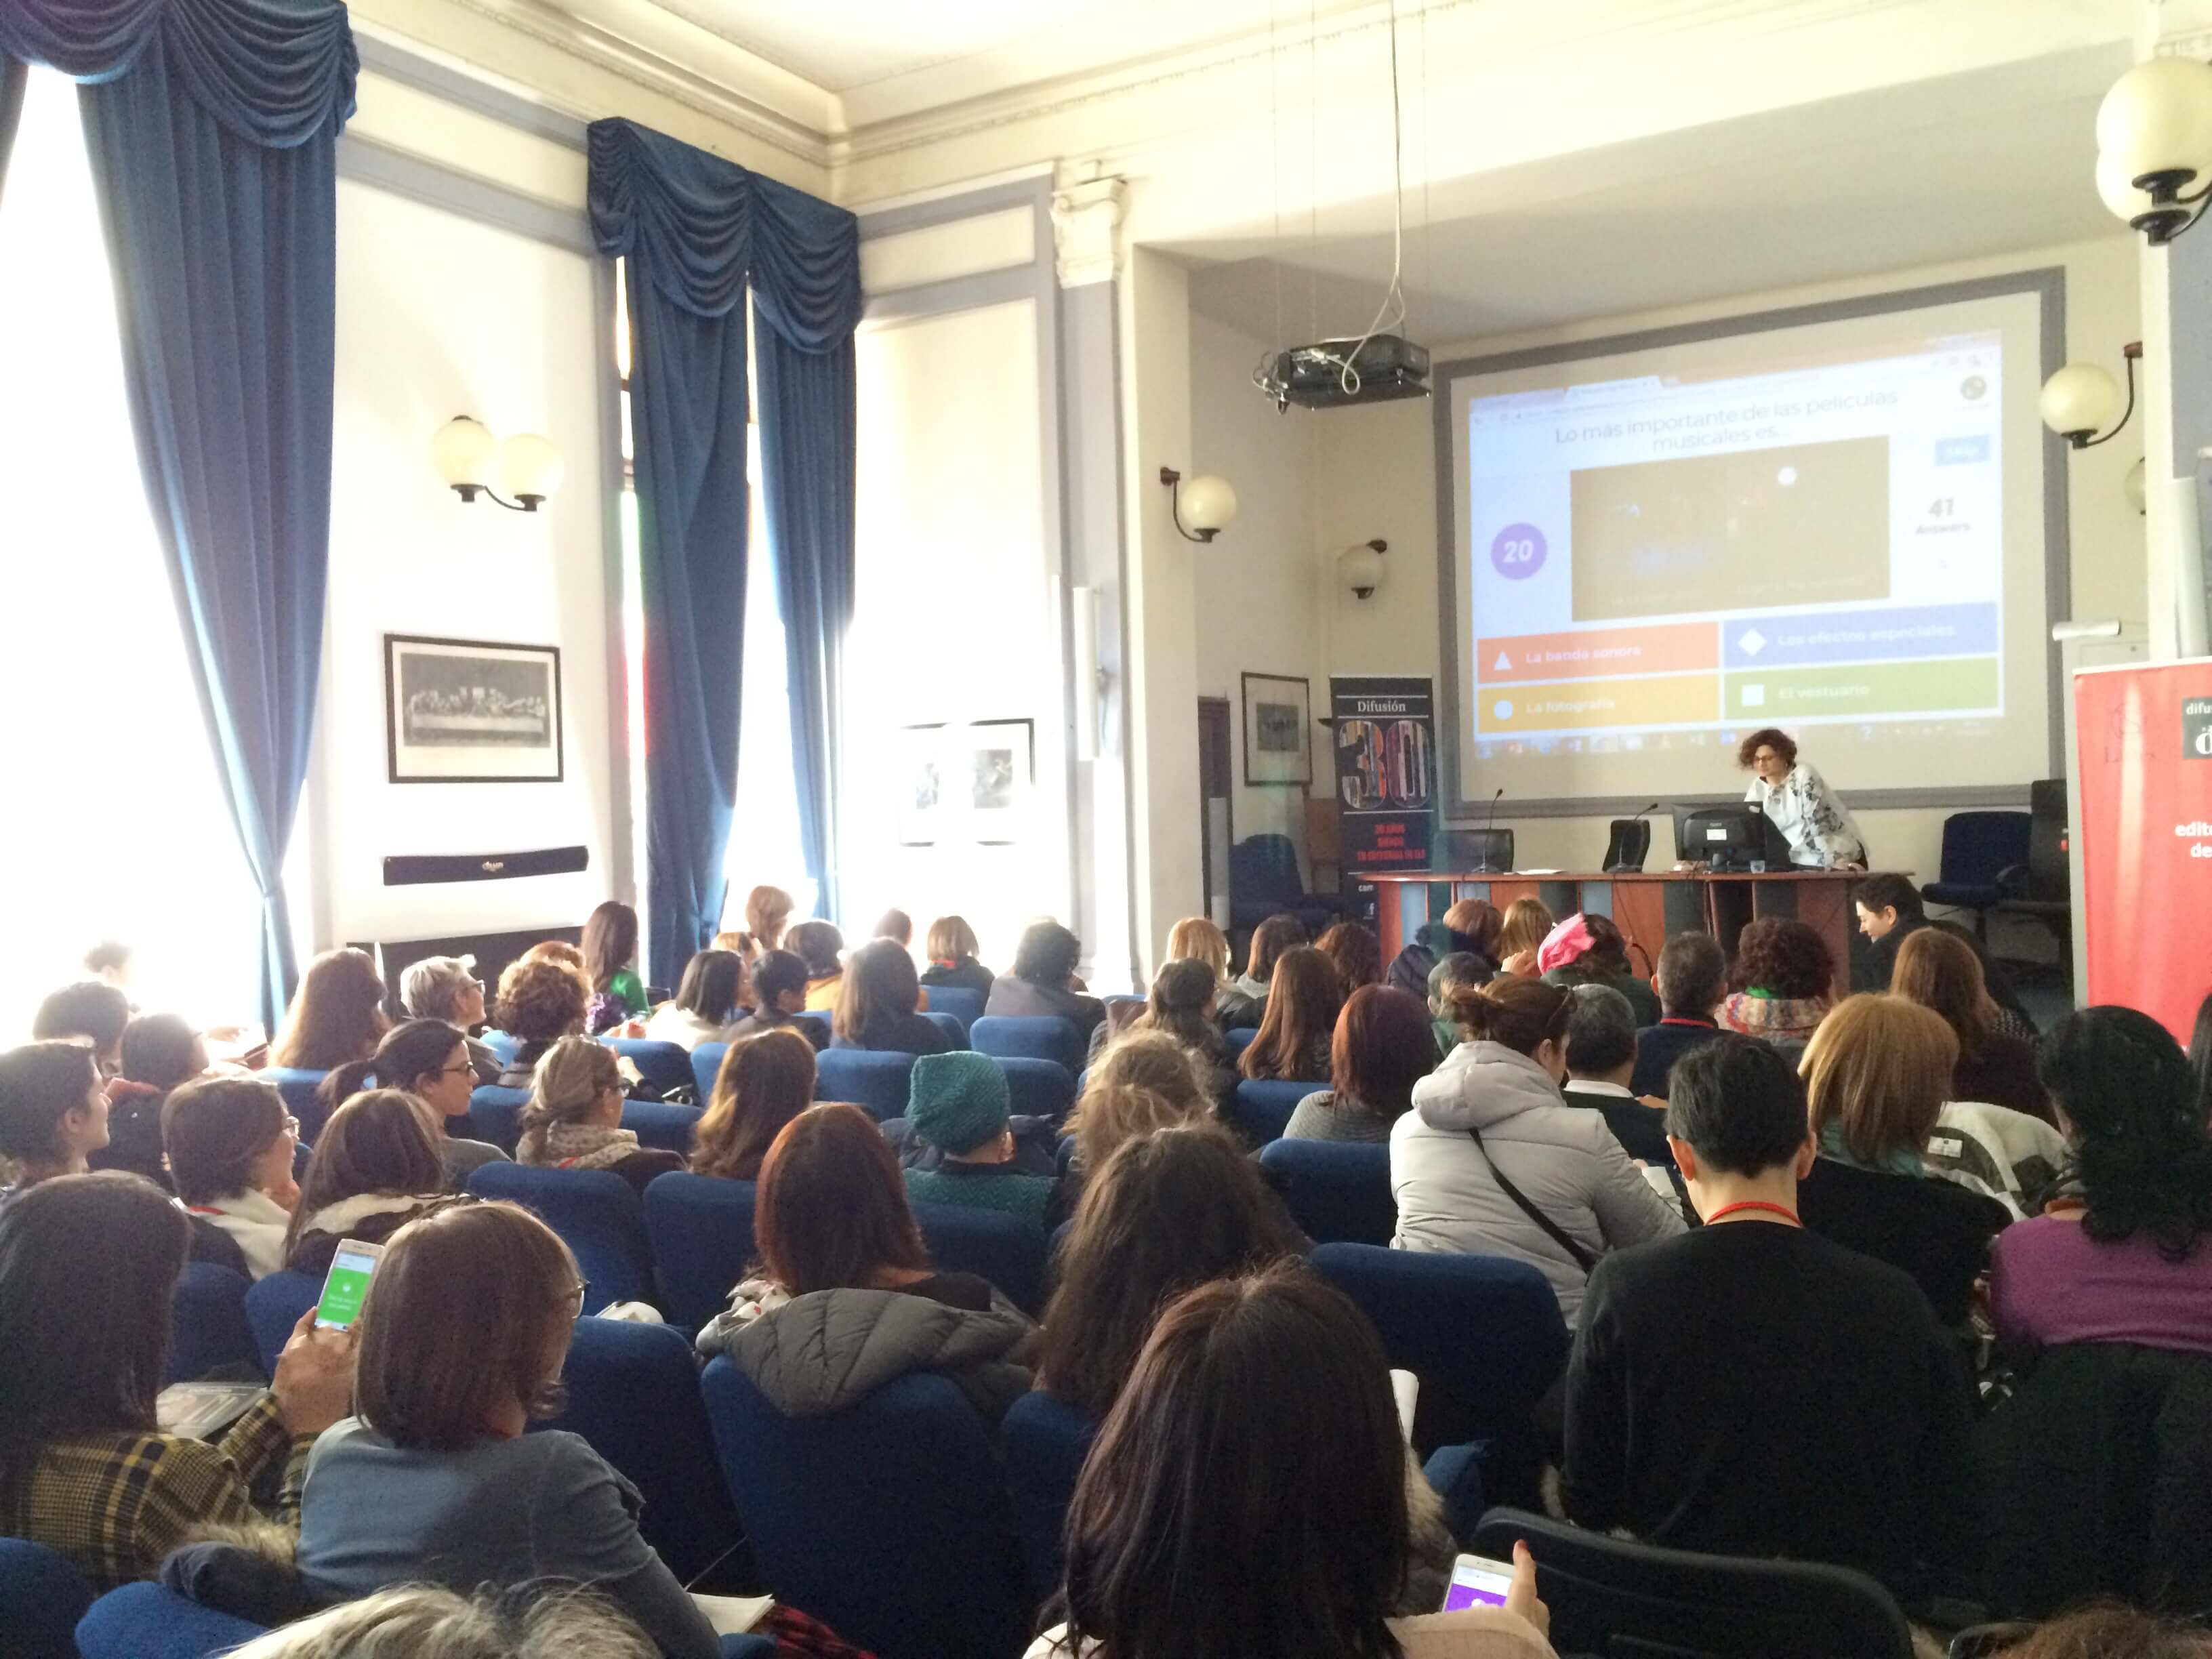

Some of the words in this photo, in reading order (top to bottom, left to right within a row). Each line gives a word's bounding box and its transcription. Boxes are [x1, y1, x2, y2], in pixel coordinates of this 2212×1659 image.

[1555, 428, 1578, 444] Lo
[1627, 409, 1738, 436] importante
[1742, 403, 1768, 422] de
[1774, 401, 1801, 418] las
[1653, 426, 1750, 453] musicales
[1929, 497, 1954, 518] 41
[1503, 539, 1534, 562] 20
[1526, 651, 1541, 663] La
[1545, 648, 1589, 663] banda
[1593, 645, 1642, 659] sonora
[1357, 699, 1407, 712] Difusión
[1527, 703, 1542, 714] La
[1339, 720, 1431, 808] 30
